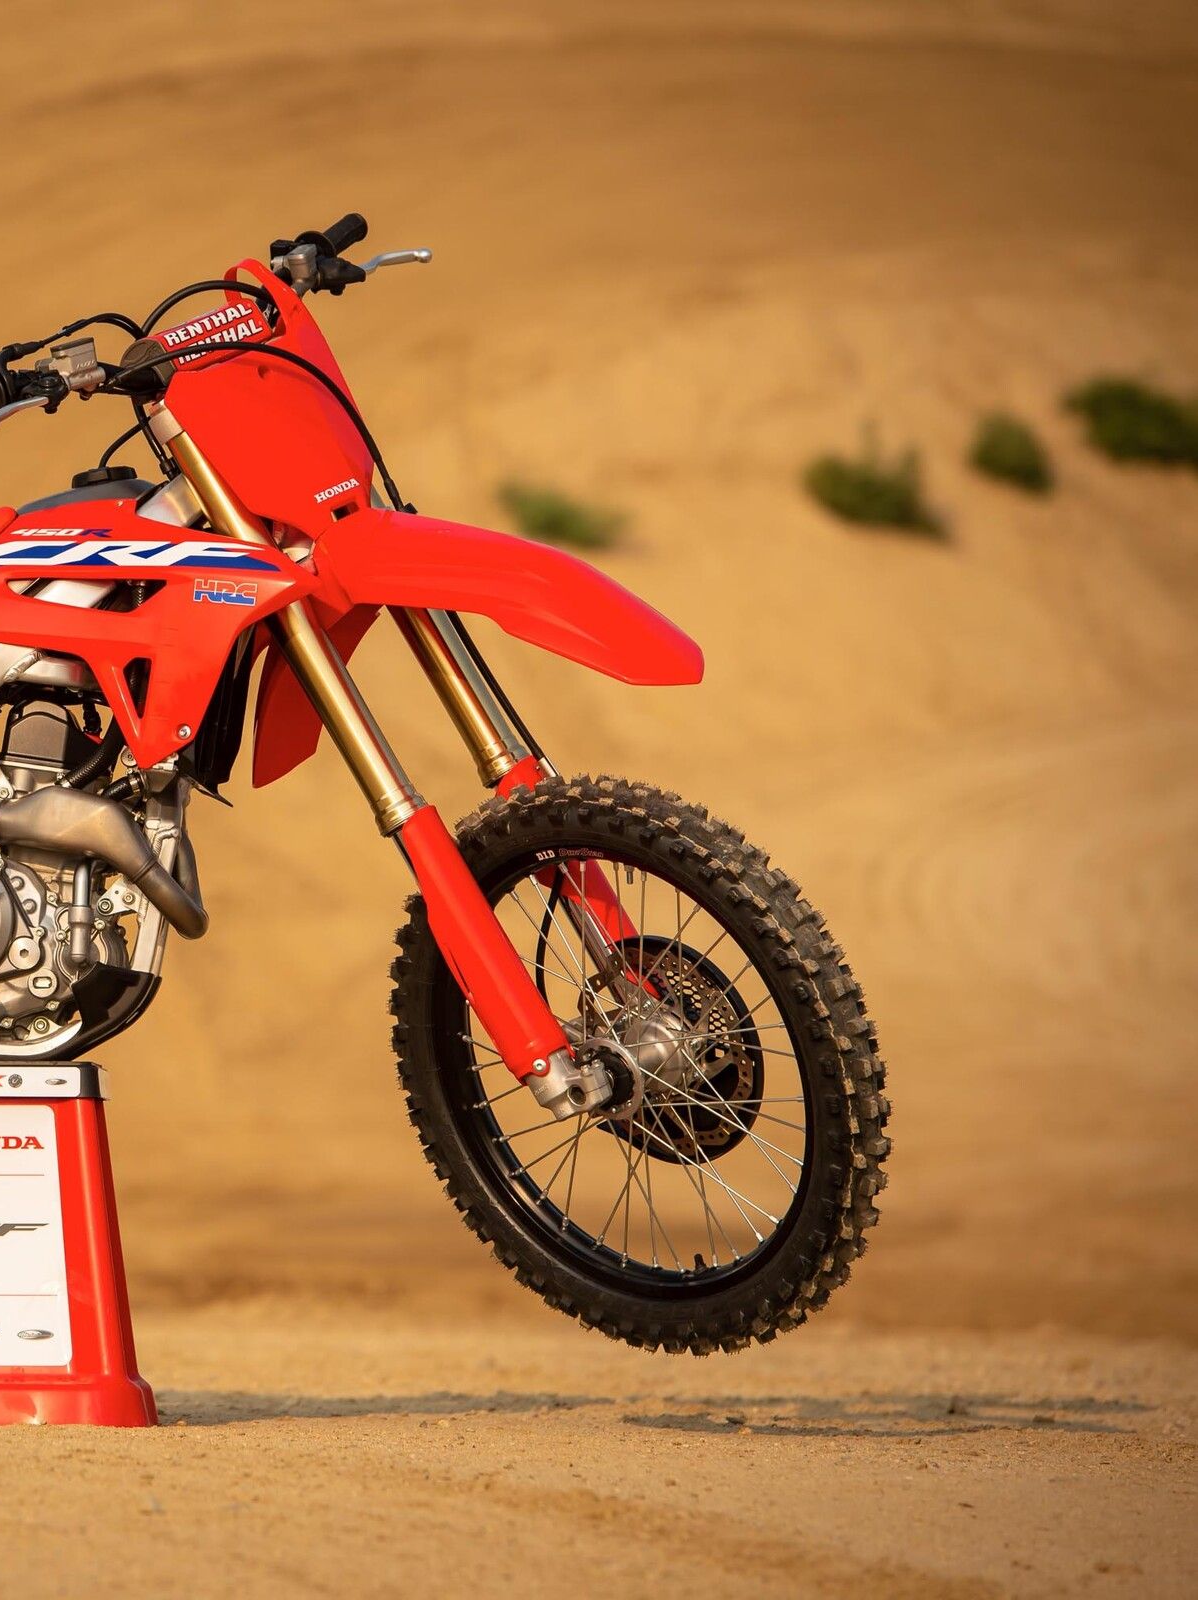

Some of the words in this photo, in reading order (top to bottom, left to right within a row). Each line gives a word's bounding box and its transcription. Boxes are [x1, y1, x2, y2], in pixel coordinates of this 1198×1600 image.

[163, 303, 253, 347] RENTHAL
[178, 319, 263, 365] THAL
[314, 478, 360, 503] HONDA
[10, 528, 113, 538] 450R
[193, 579, 259, 606] HRC
